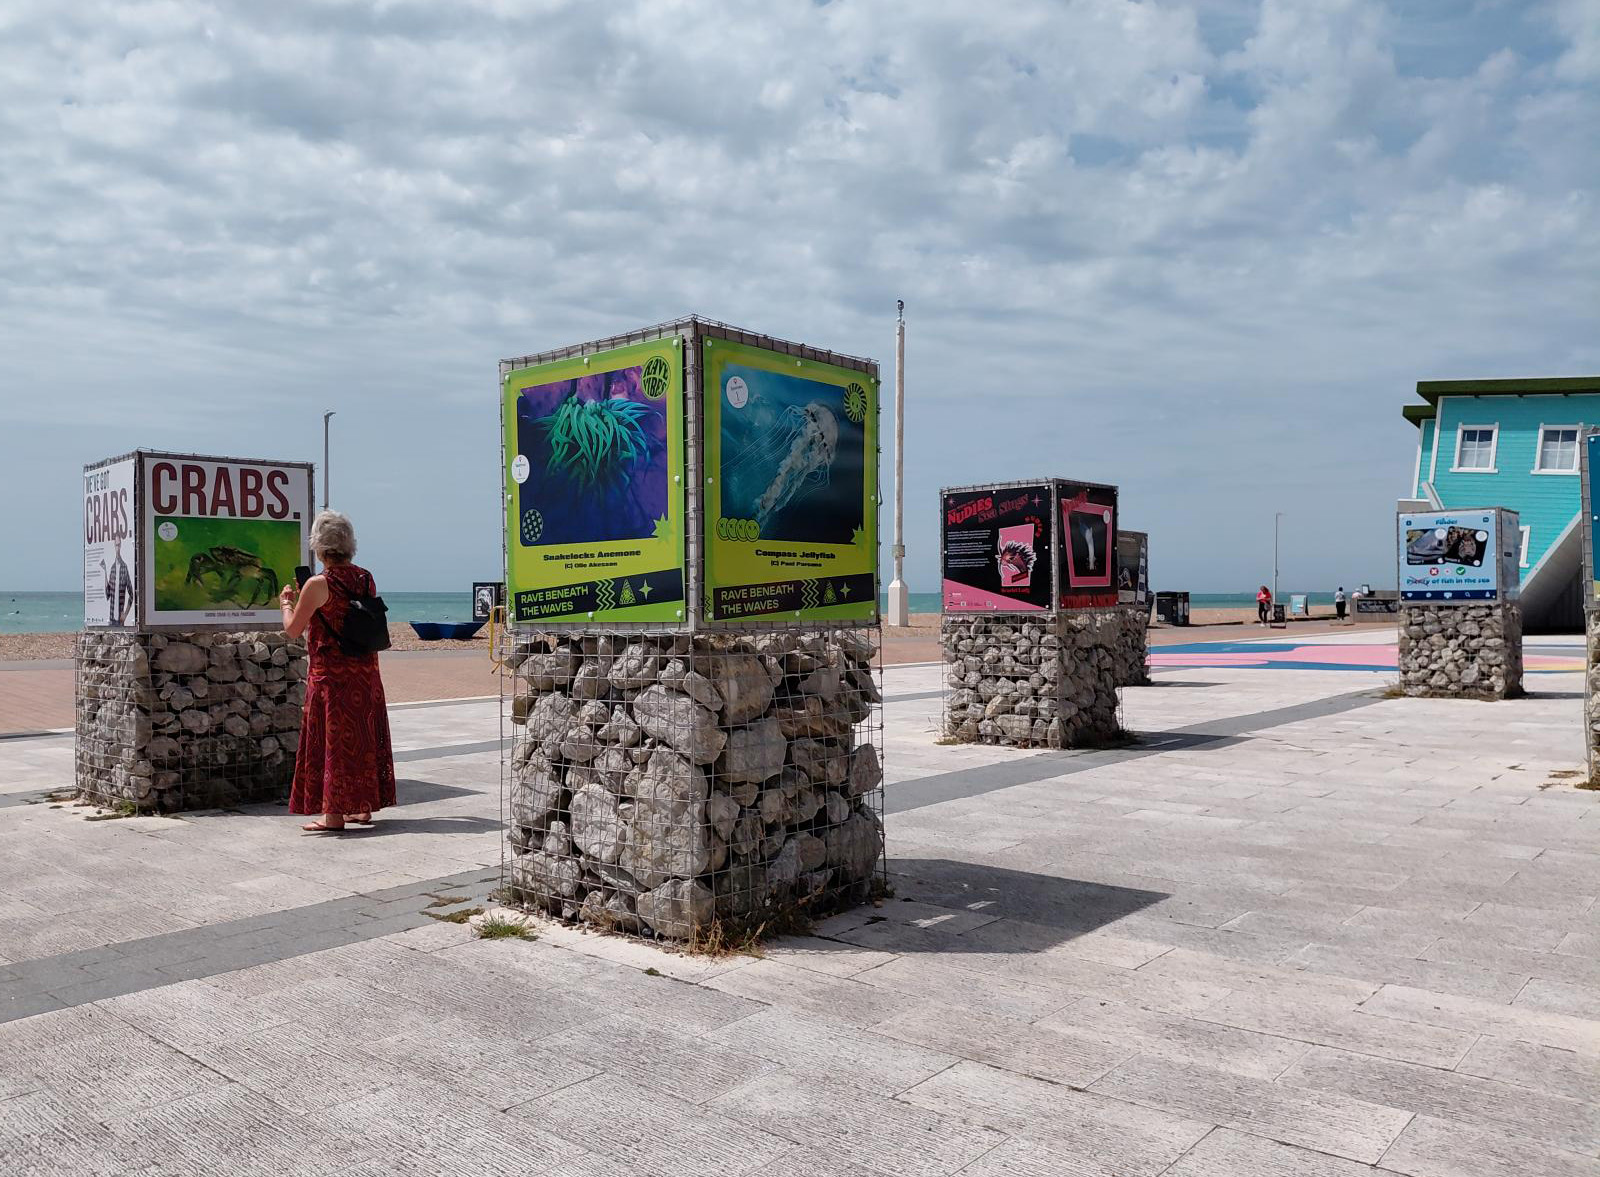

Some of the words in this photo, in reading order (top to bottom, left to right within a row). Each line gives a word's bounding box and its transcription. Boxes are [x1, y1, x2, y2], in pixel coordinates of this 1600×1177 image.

[643, 357, 668, 379] RAVE
[643, 377, 667, 397] VIBES
[152, 462, 300, 519] CRABS.
[86, 487, 132, 544] CRABS.
[948, 496, 993, 526] NUDIES
[543, 552, 595, 561] Snakelocks
[597, 550, 641, 558] Anemone
[755, 549, 797, 558] Compass
[799, 551, 836, 560] Jellyfish
[520, 589, 543, 604] RAVE
[545, 584, 589, 601] BENEATH
[721, 588, 748, 601] RAVE
[750, 584, 794, 598] BENEATH
[521, 603, 539, 617] THE
[540, 601, 574, 615] WAVES
[721, 603, 742, 615] THE
[743, 599, 780, 612] WAVES
